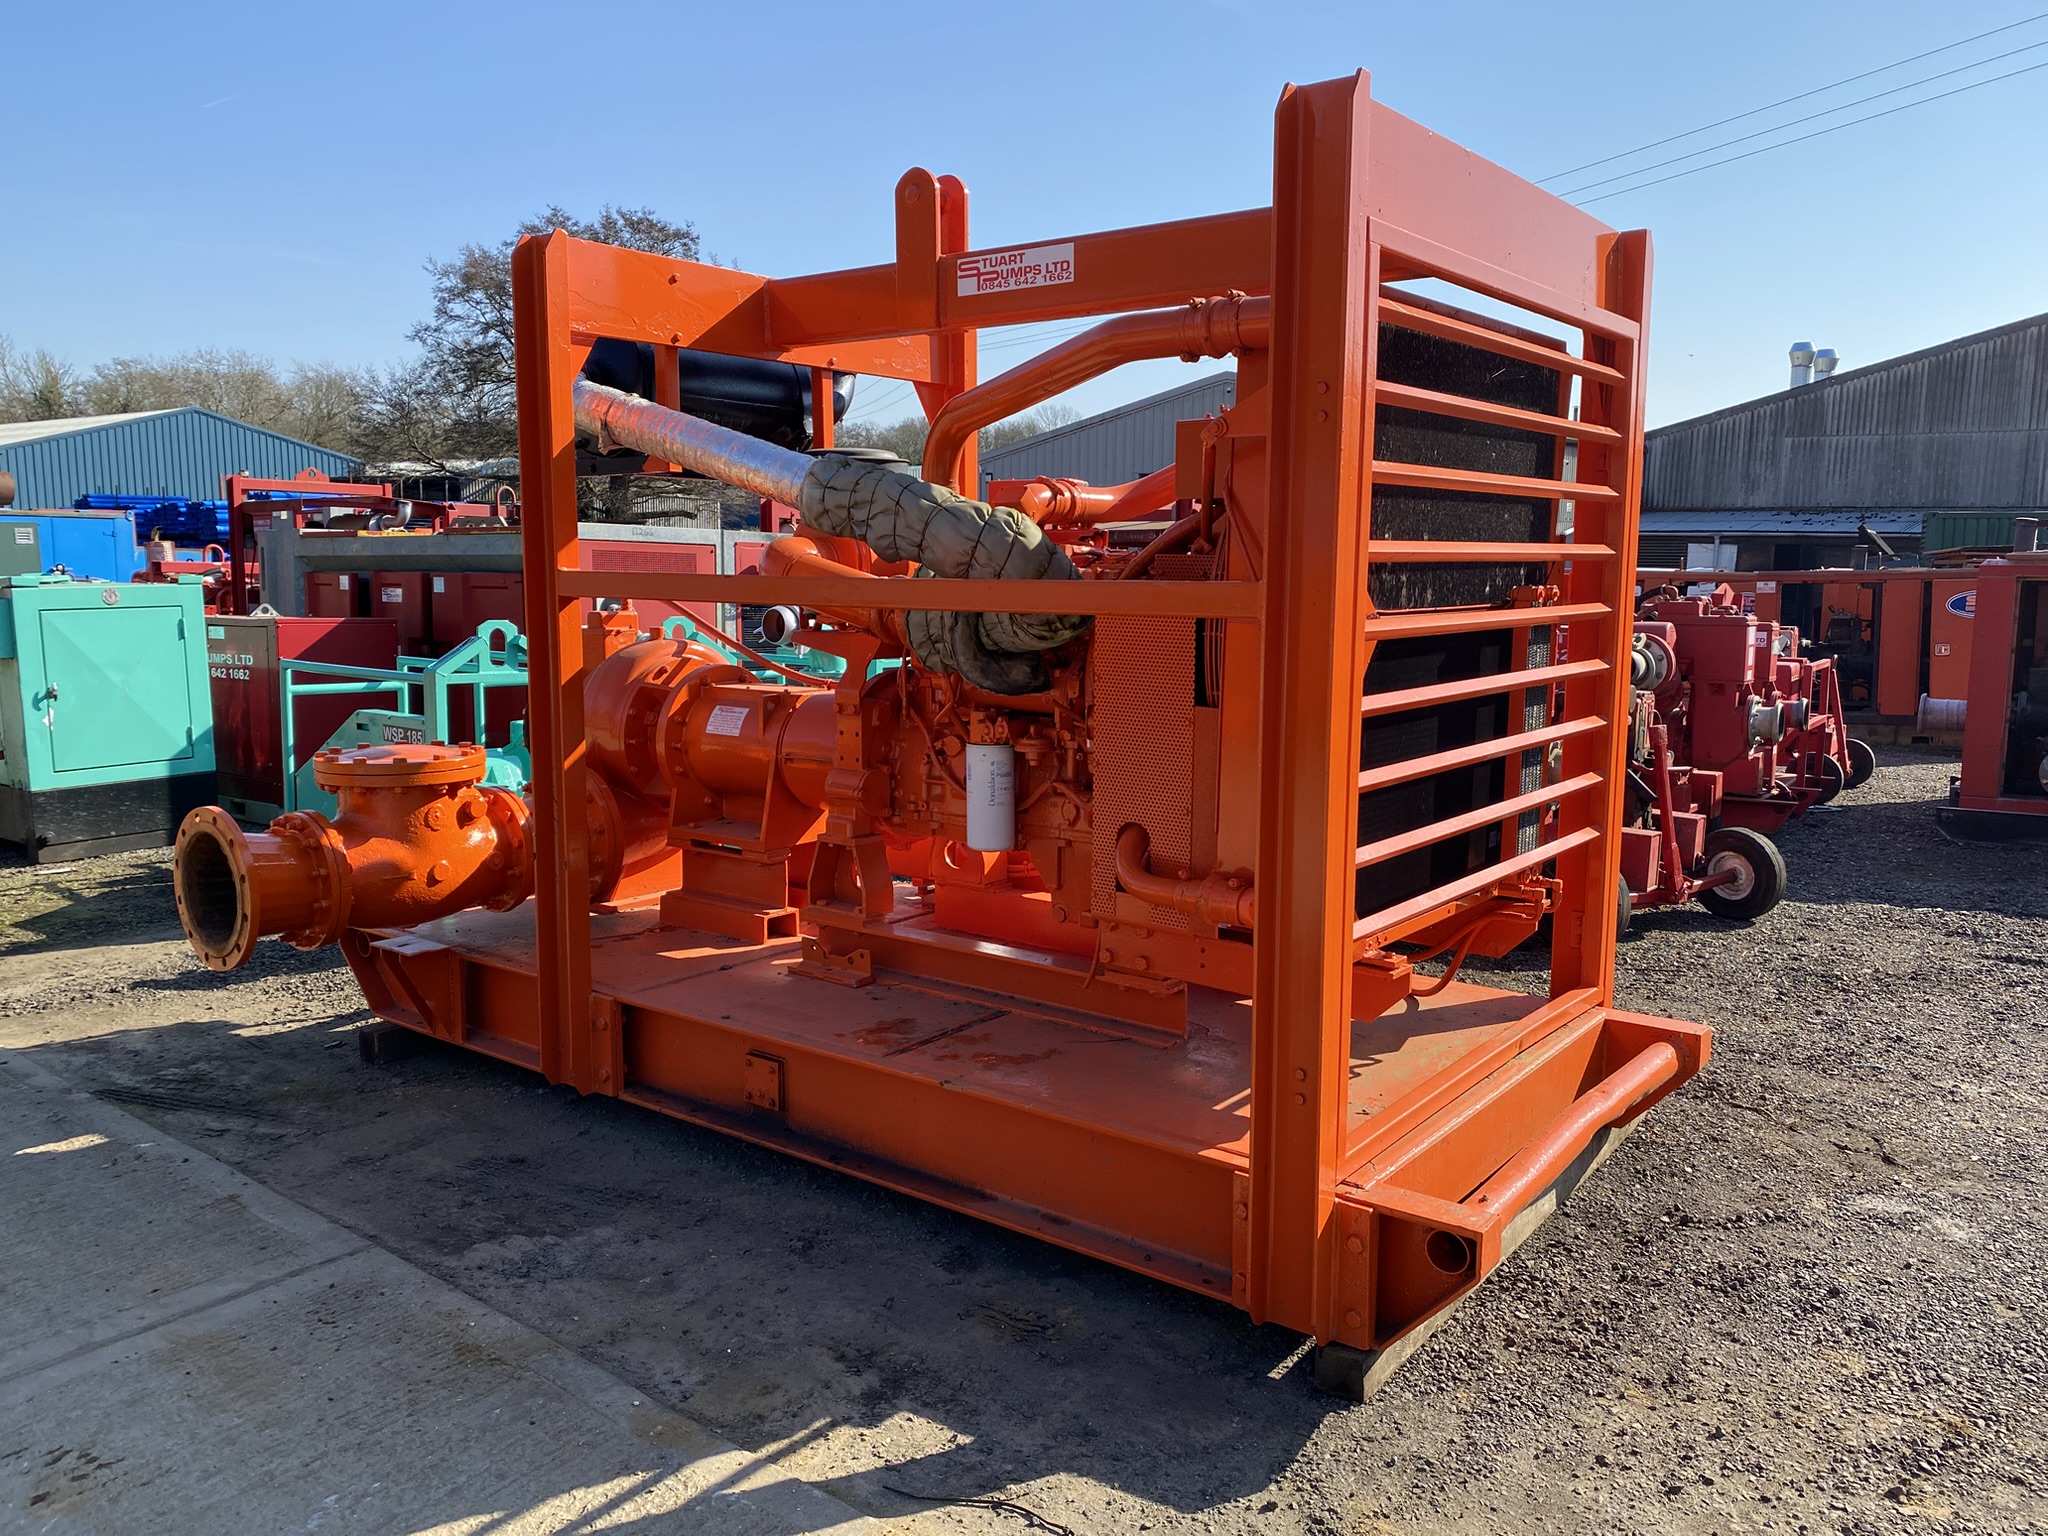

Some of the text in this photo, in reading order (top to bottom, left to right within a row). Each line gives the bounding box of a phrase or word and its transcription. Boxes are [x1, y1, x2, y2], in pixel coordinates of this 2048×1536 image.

[958, 252, 1025, 279] STUART
[977, 260, 1070, 291] PUMPS LTD
[981, 270, 1072, 291] 0845 642 1662
[235, 654, 253, 665] LTD
[210, 667, 250, 680] 642 1662
[383, 726, 423, 745] WSP 185
